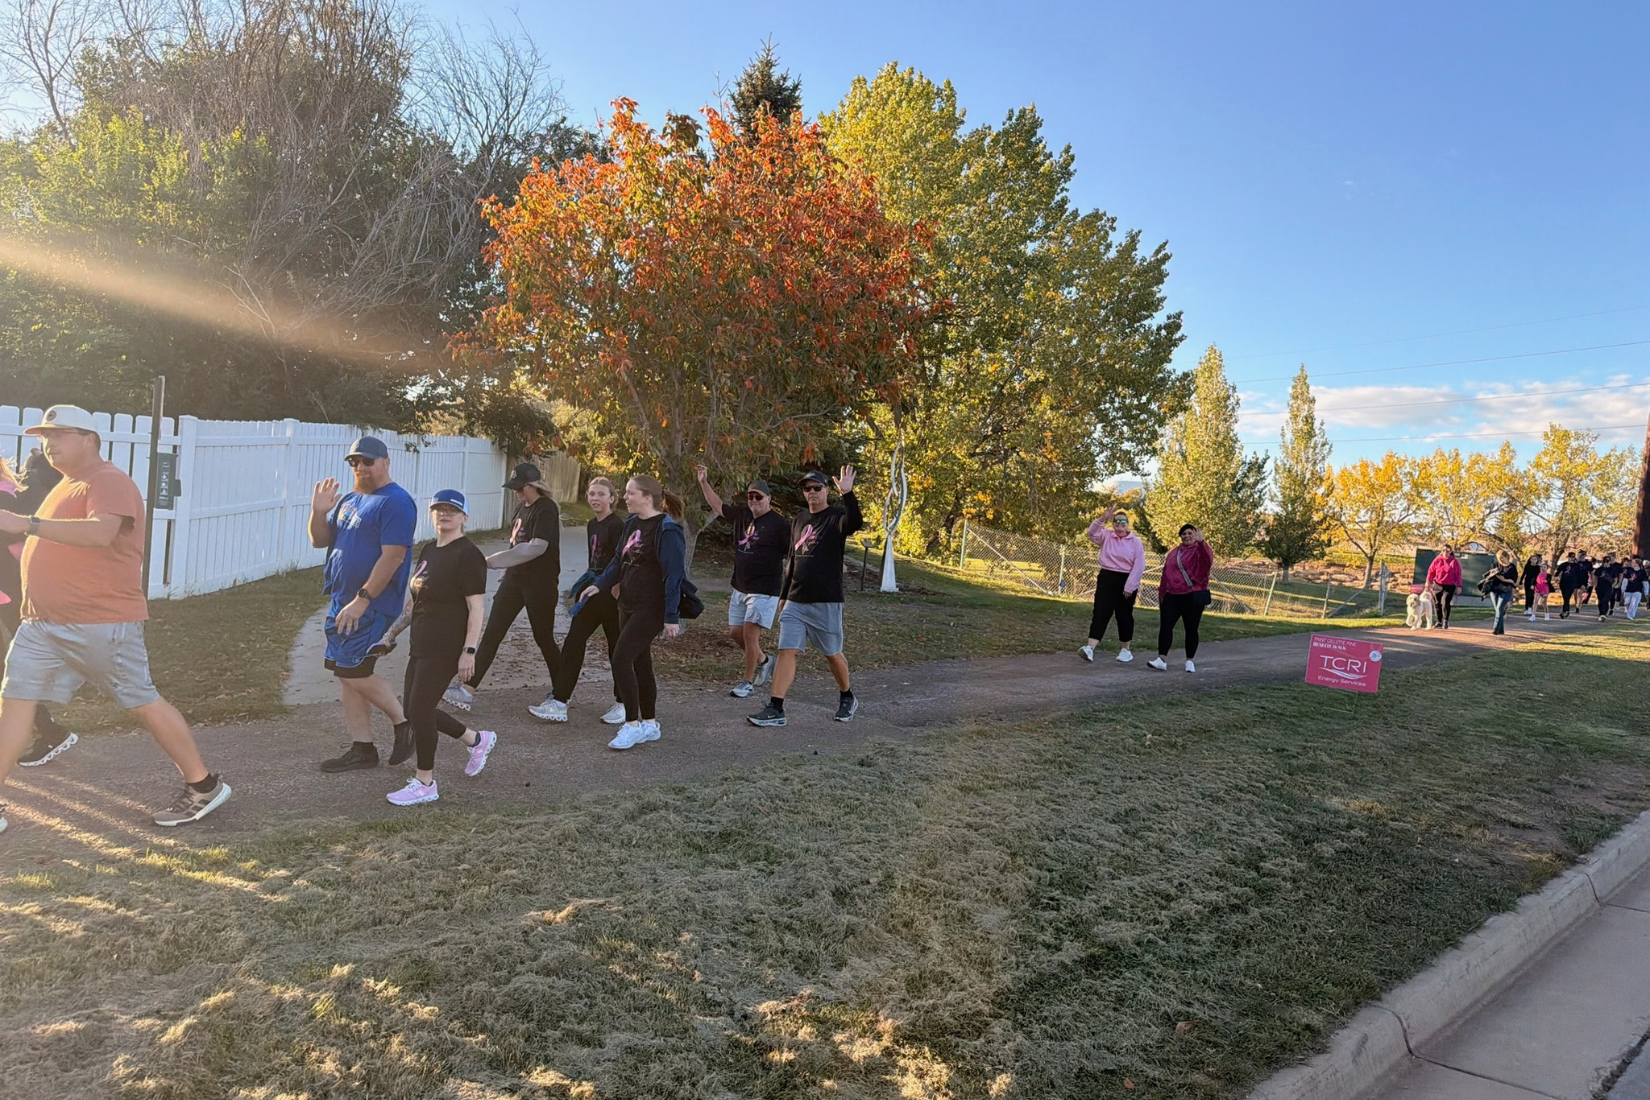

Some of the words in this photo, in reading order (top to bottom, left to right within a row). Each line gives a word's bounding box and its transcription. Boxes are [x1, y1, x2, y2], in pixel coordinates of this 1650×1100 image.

[1320, 654, 1367, 673] TCRI
[1317, 675, 1339, 683] Energy
[1340, 679, 1366, 687] Services
